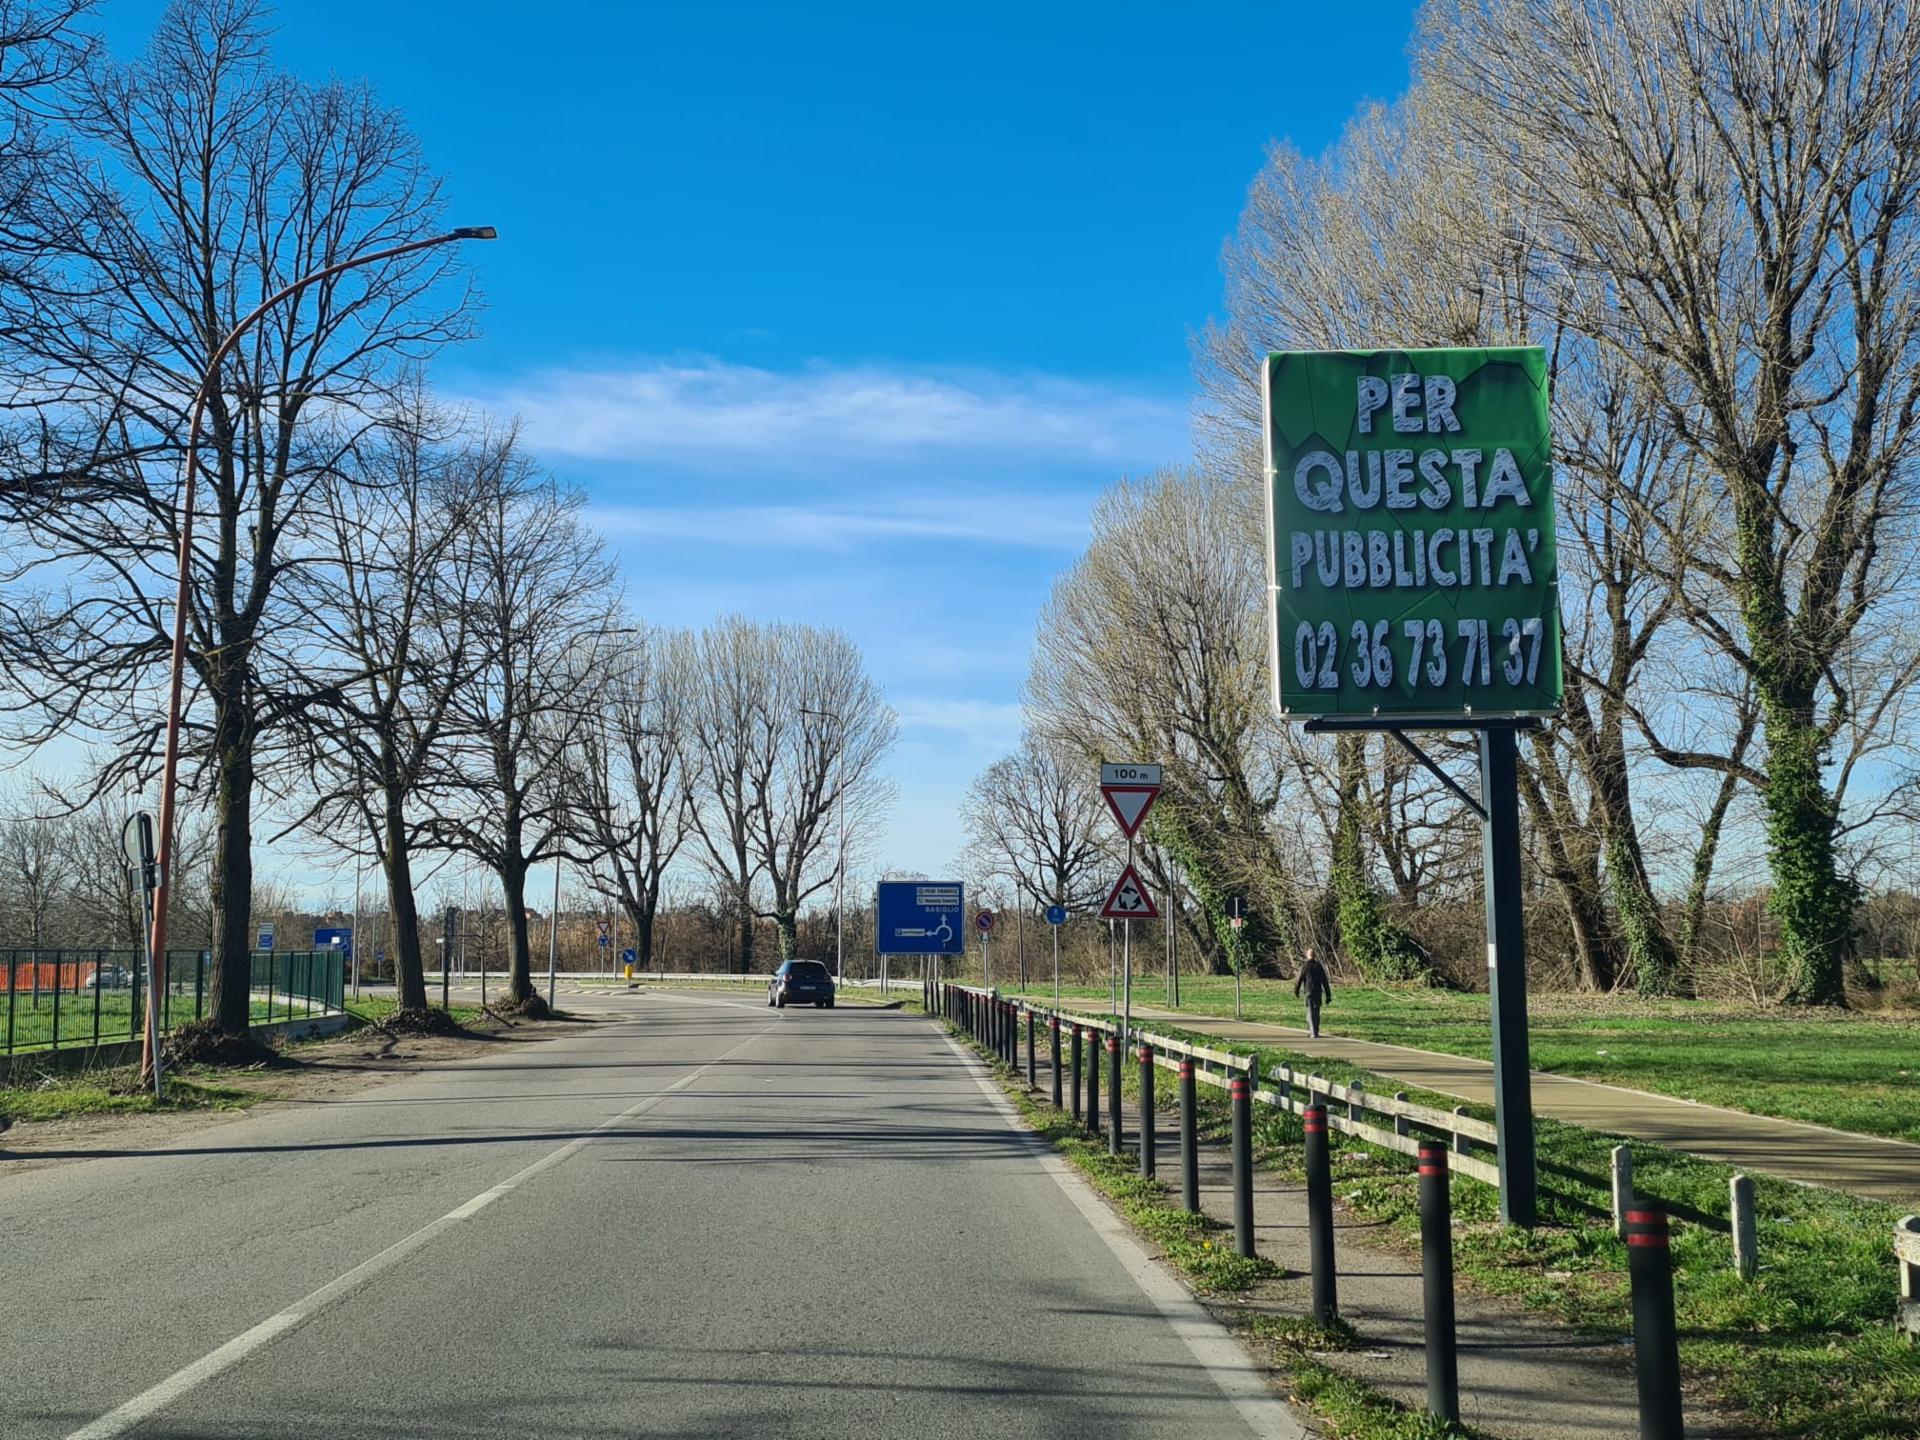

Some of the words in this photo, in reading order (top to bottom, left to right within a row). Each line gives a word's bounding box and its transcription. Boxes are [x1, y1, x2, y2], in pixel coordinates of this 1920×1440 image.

[1356, 373, 1461, 433] PER
[1293, 447, 1532, 513] QUESTA
[1290, 528, 1539, 588] PUBBLICITA'
[1295, 620, 1339, 689] 02
[1350, 619, 1393, 689] 36
[1404, 618, 1447, 688] 73
[1458, 618, 1491, 686] 71
[1502, 617, 1543, 686] 37
[1114, 769, 1137, 779] 100
